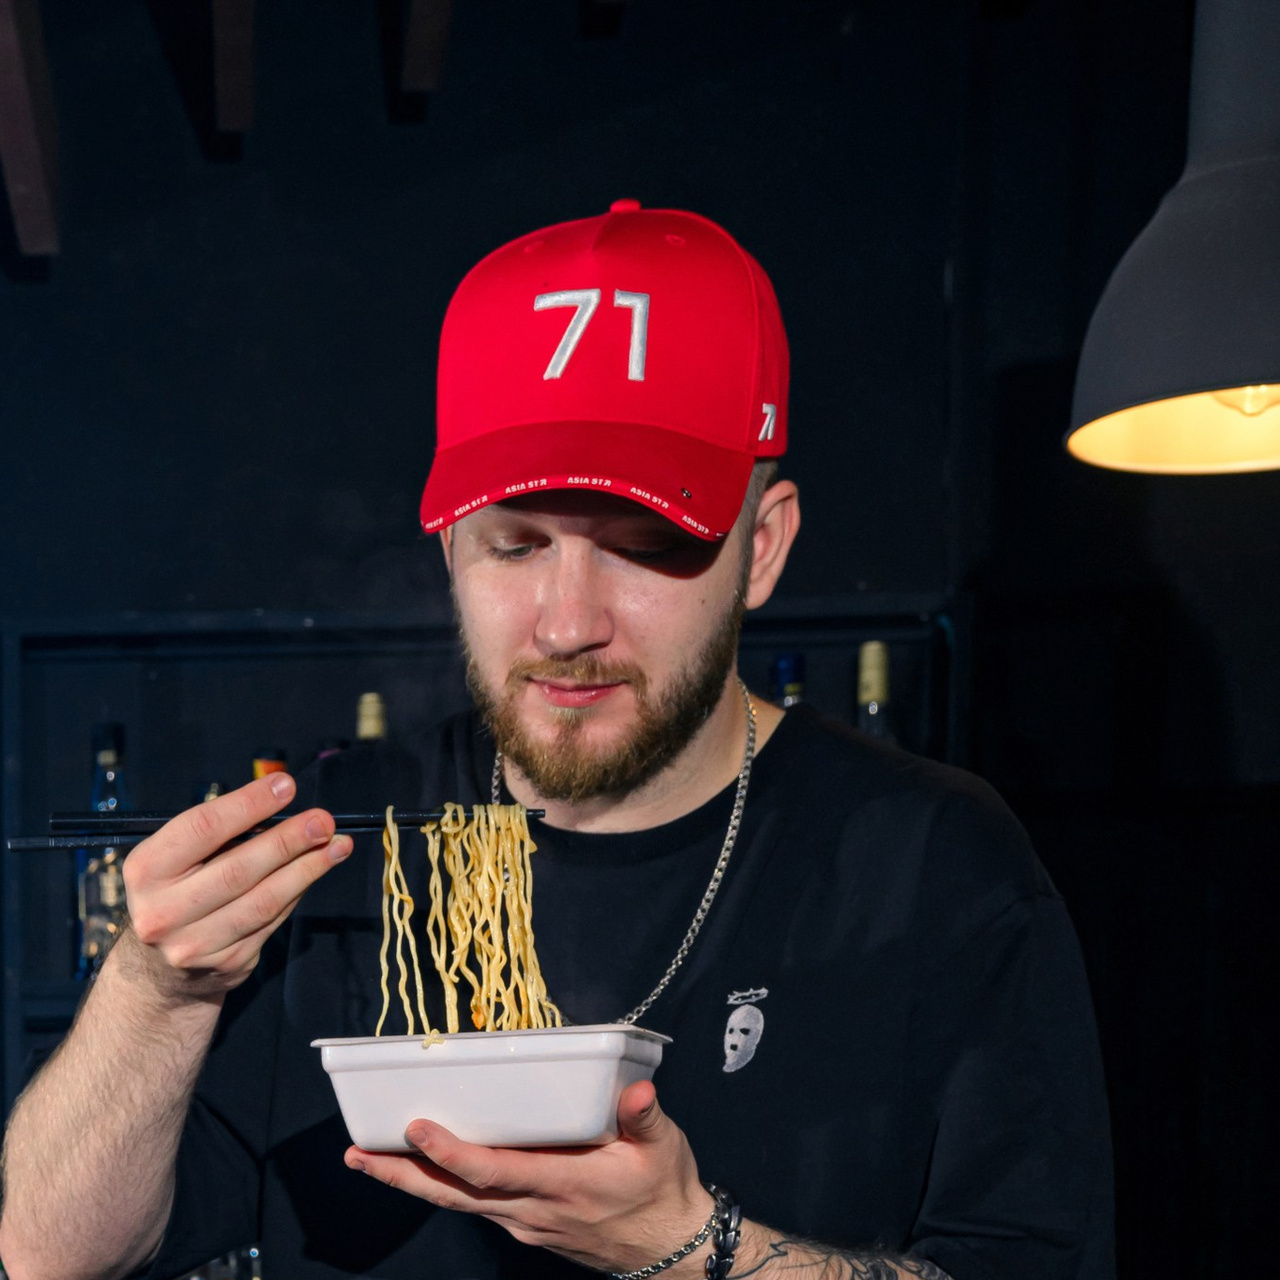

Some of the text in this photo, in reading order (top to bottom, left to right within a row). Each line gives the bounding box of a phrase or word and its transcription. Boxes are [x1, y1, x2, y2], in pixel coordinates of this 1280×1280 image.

[534, 289, 650, 381] 71
[567, 476, 590, 485] ASIA
[505, 482, 526, 494] ASIA
[454, 503, 471, 517] ASIA
